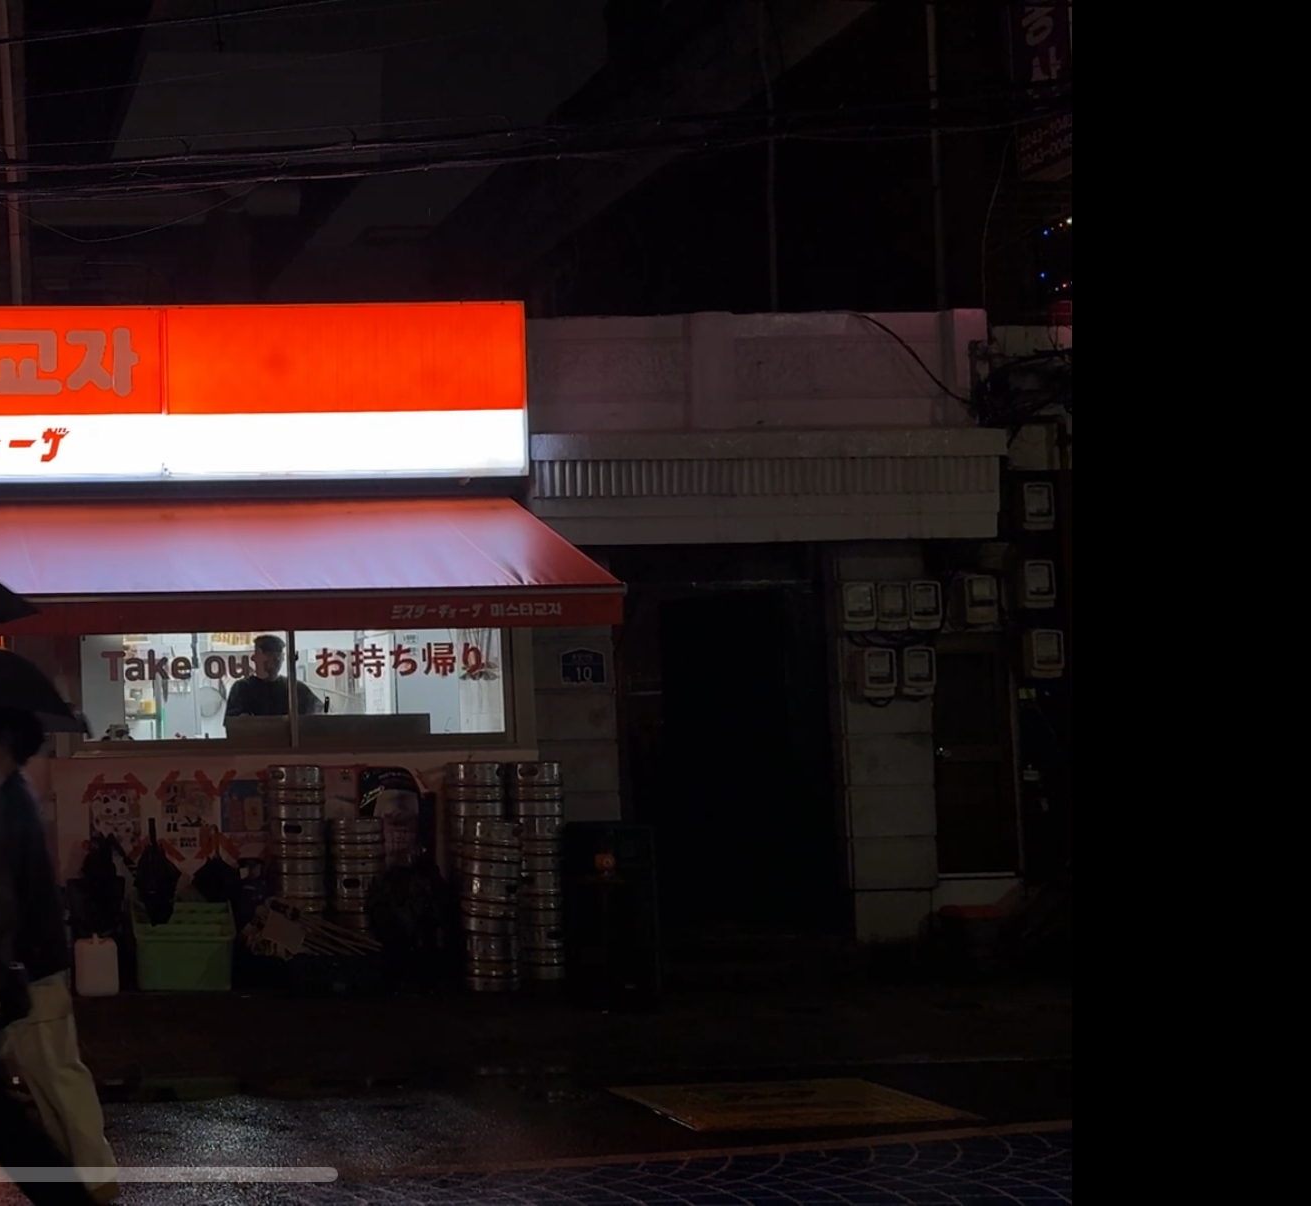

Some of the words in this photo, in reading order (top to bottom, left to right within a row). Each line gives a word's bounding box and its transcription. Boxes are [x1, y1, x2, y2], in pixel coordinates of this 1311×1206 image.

[490, 602, 563, 617] 미스타교자
[101, 650, 193, 682] Take
[315, 642, 486, 679] お持ち帰り
[575, 666, 593, 681] 10
